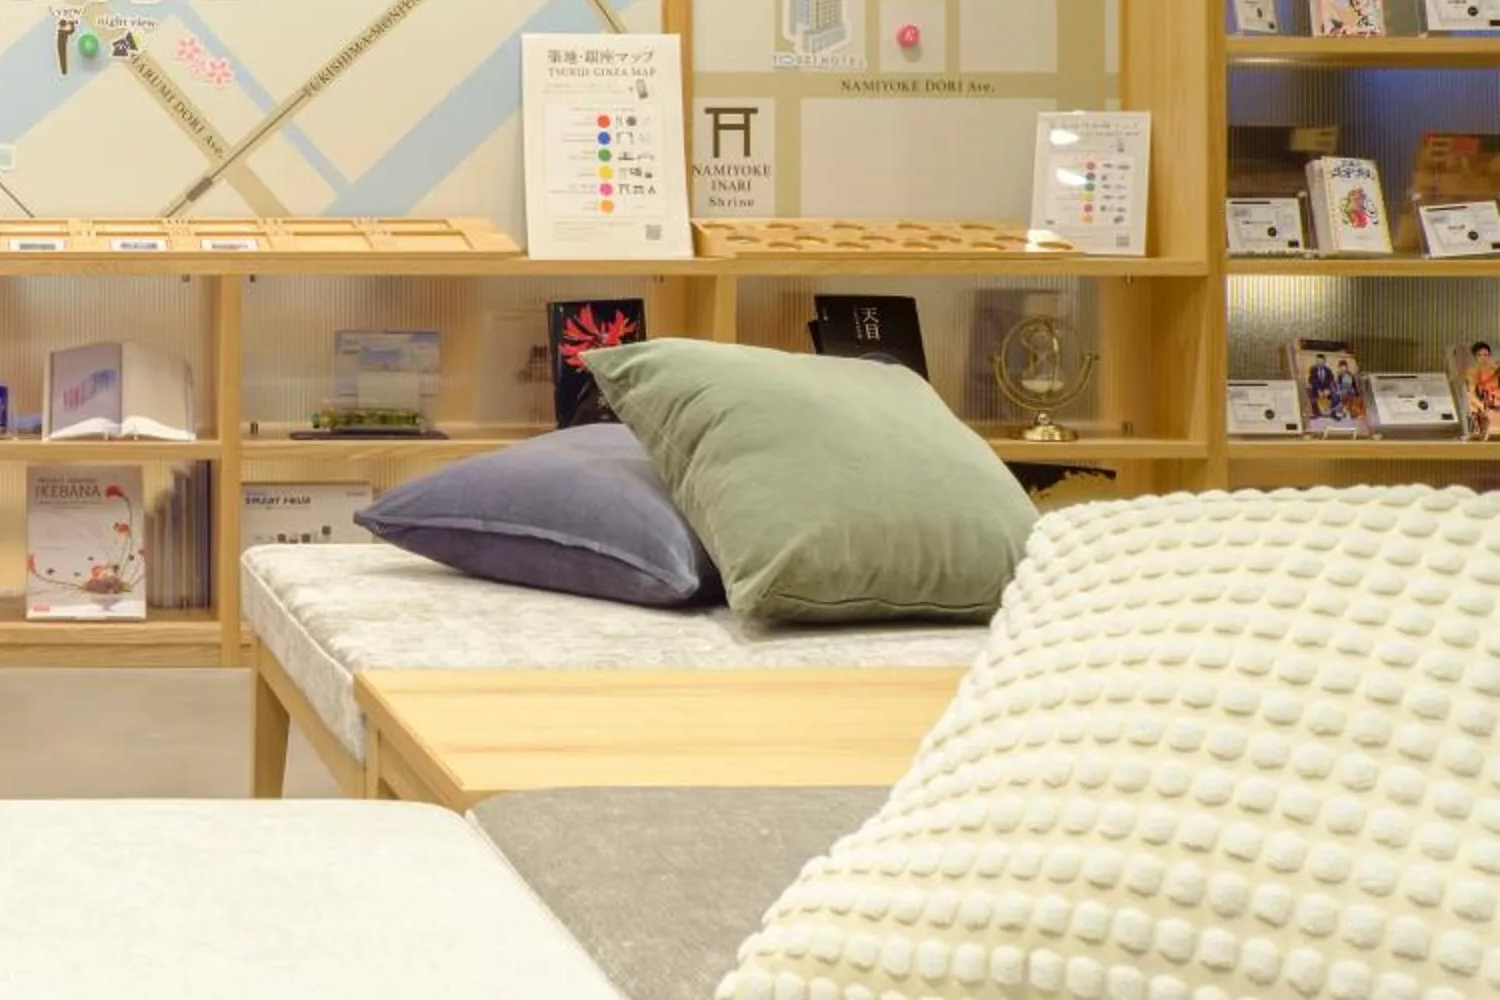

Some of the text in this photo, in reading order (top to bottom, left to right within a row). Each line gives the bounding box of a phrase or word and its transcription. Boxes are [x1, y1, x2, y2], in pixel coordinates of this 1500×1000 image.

[841, 80, 995, 93] NAMIYOKE DORI Ave.
[692, 164, 772, 177] NAMIYOKE
[711, 180, 752, 192] INARI
[35, 484, 102, 499] IKEBANA
